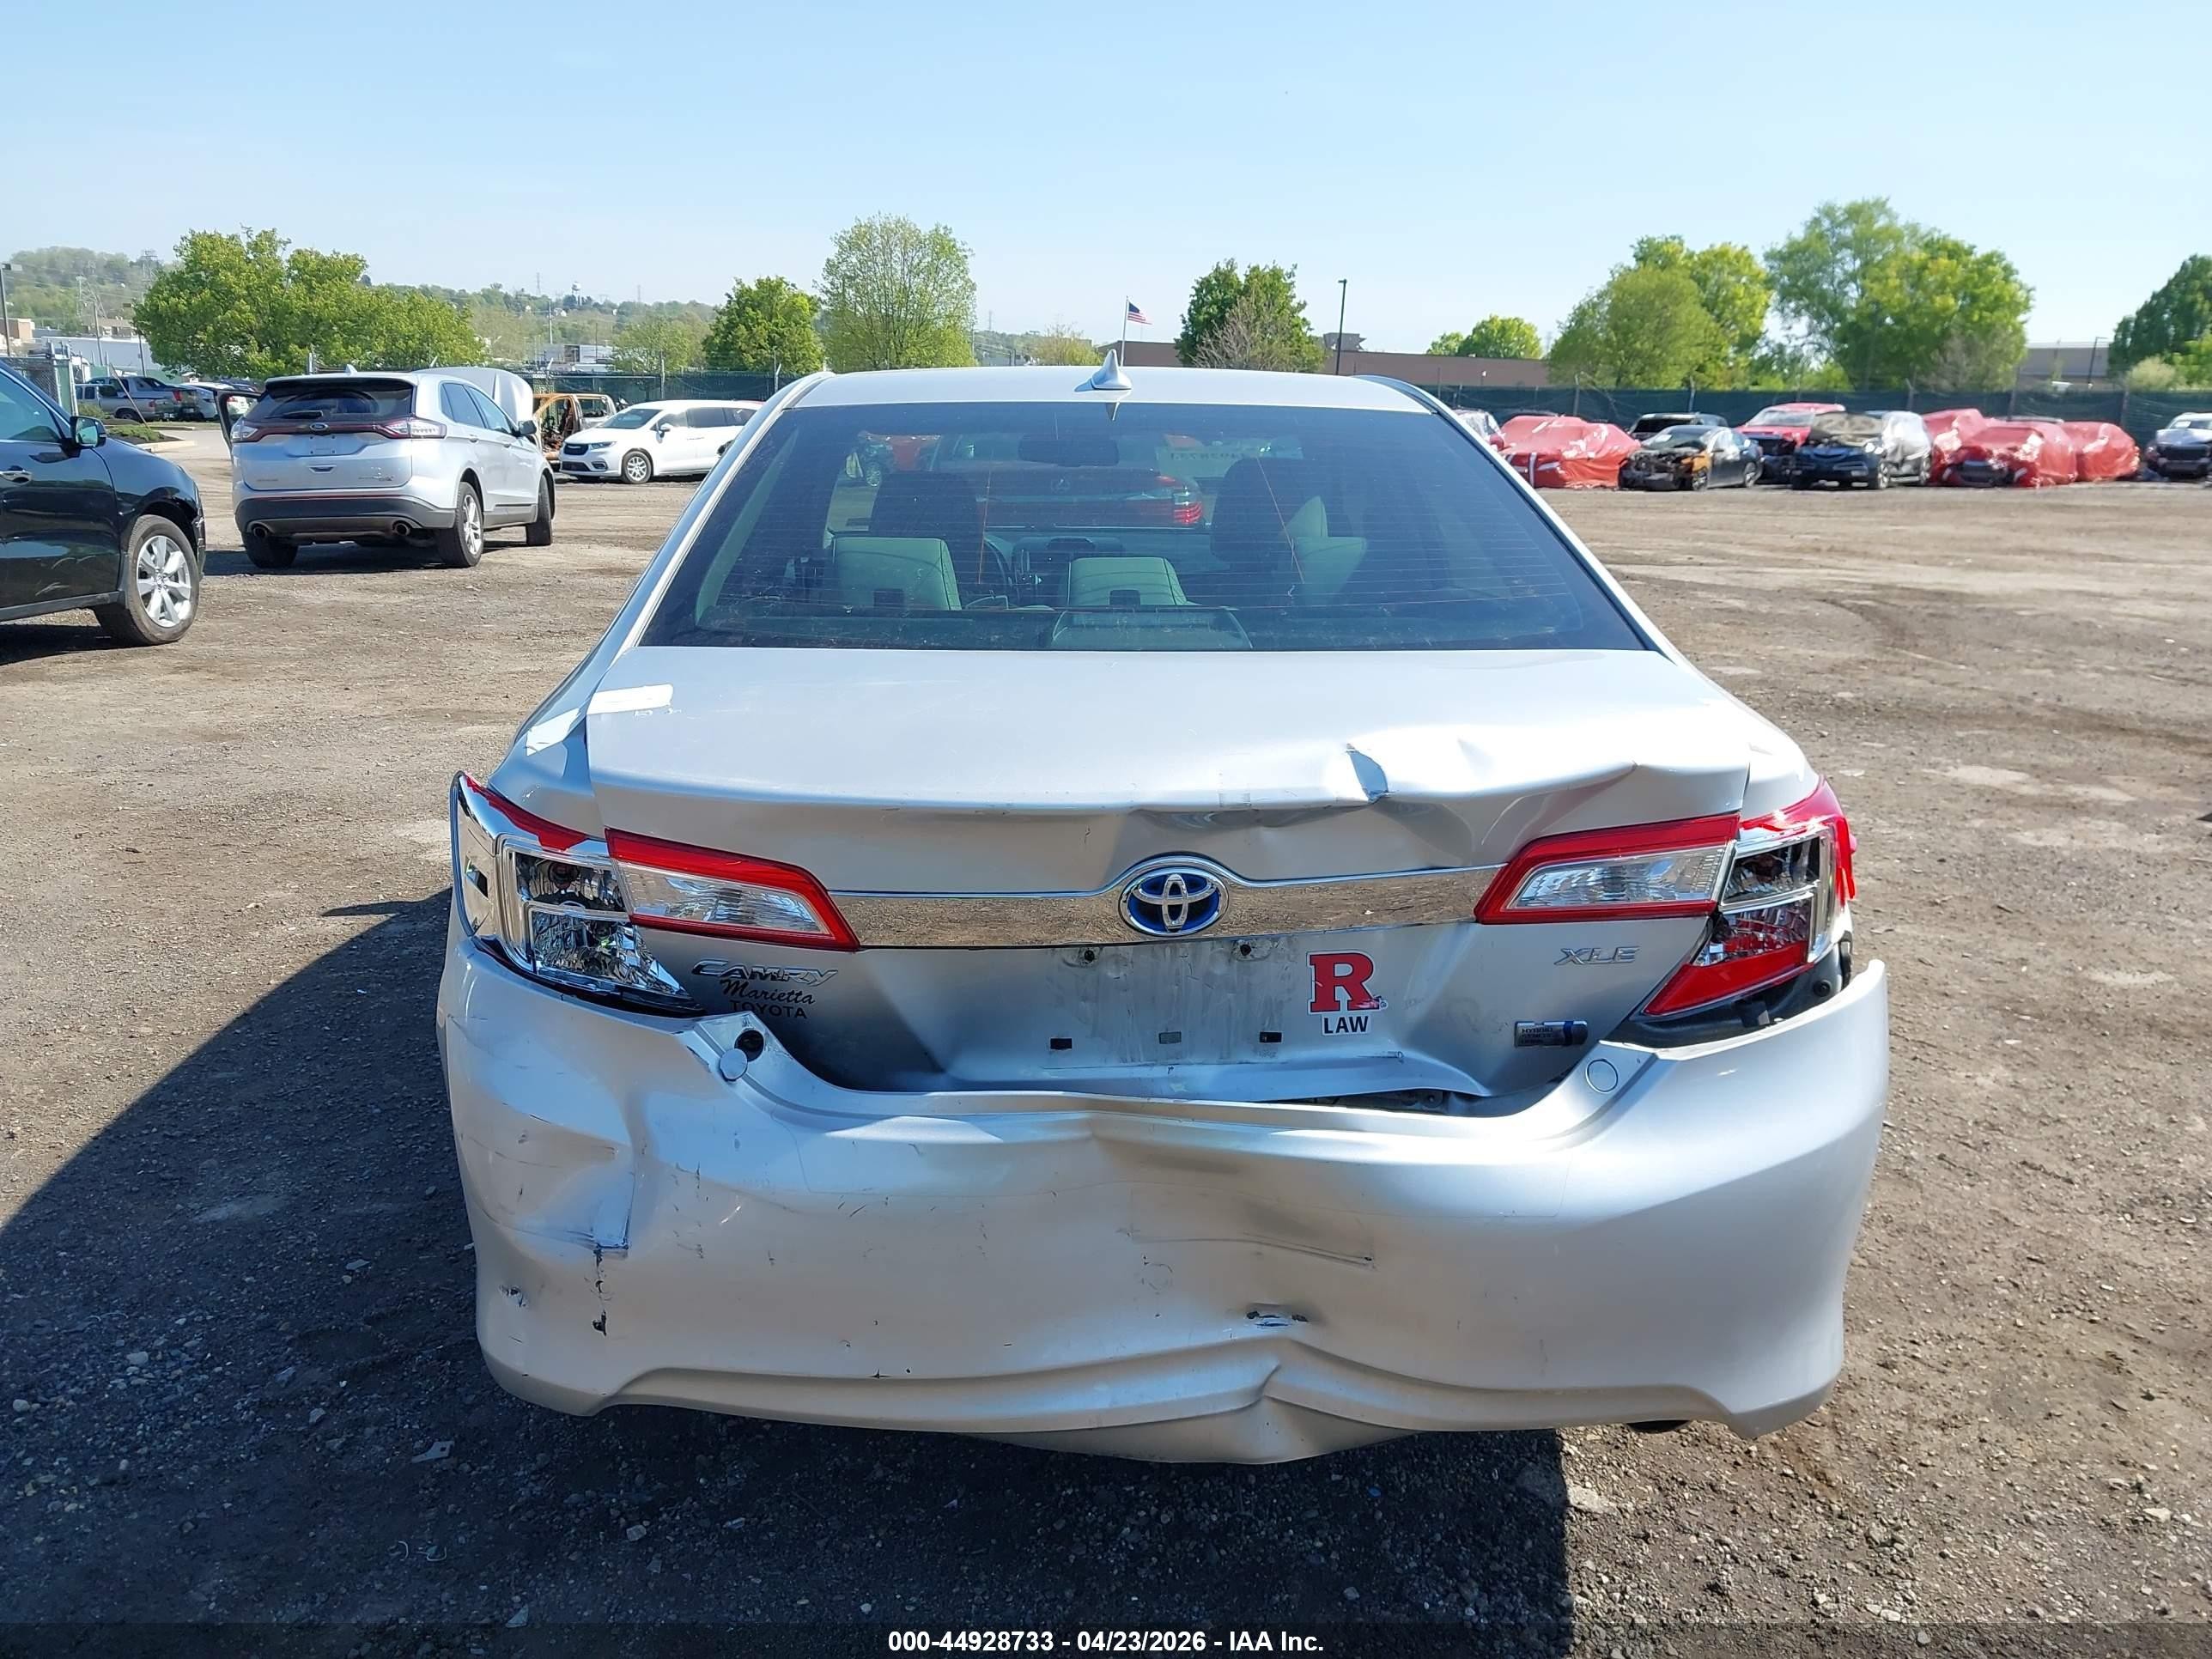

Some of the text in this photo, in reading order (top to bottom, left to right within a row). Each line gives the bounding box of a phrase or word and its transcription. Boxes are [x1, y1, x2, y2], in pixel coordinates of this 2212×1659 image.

[1553, 945, 1642, 965] XLE
[691, 958, 839, 987] CAMRY
[1310, 952, 1381, 1012] R
[720, 979, 816, 1005] Marietta
[730, 1000, 808, 1019] TOYOTA
[1323, 1016, 1369, 1034] LAW
